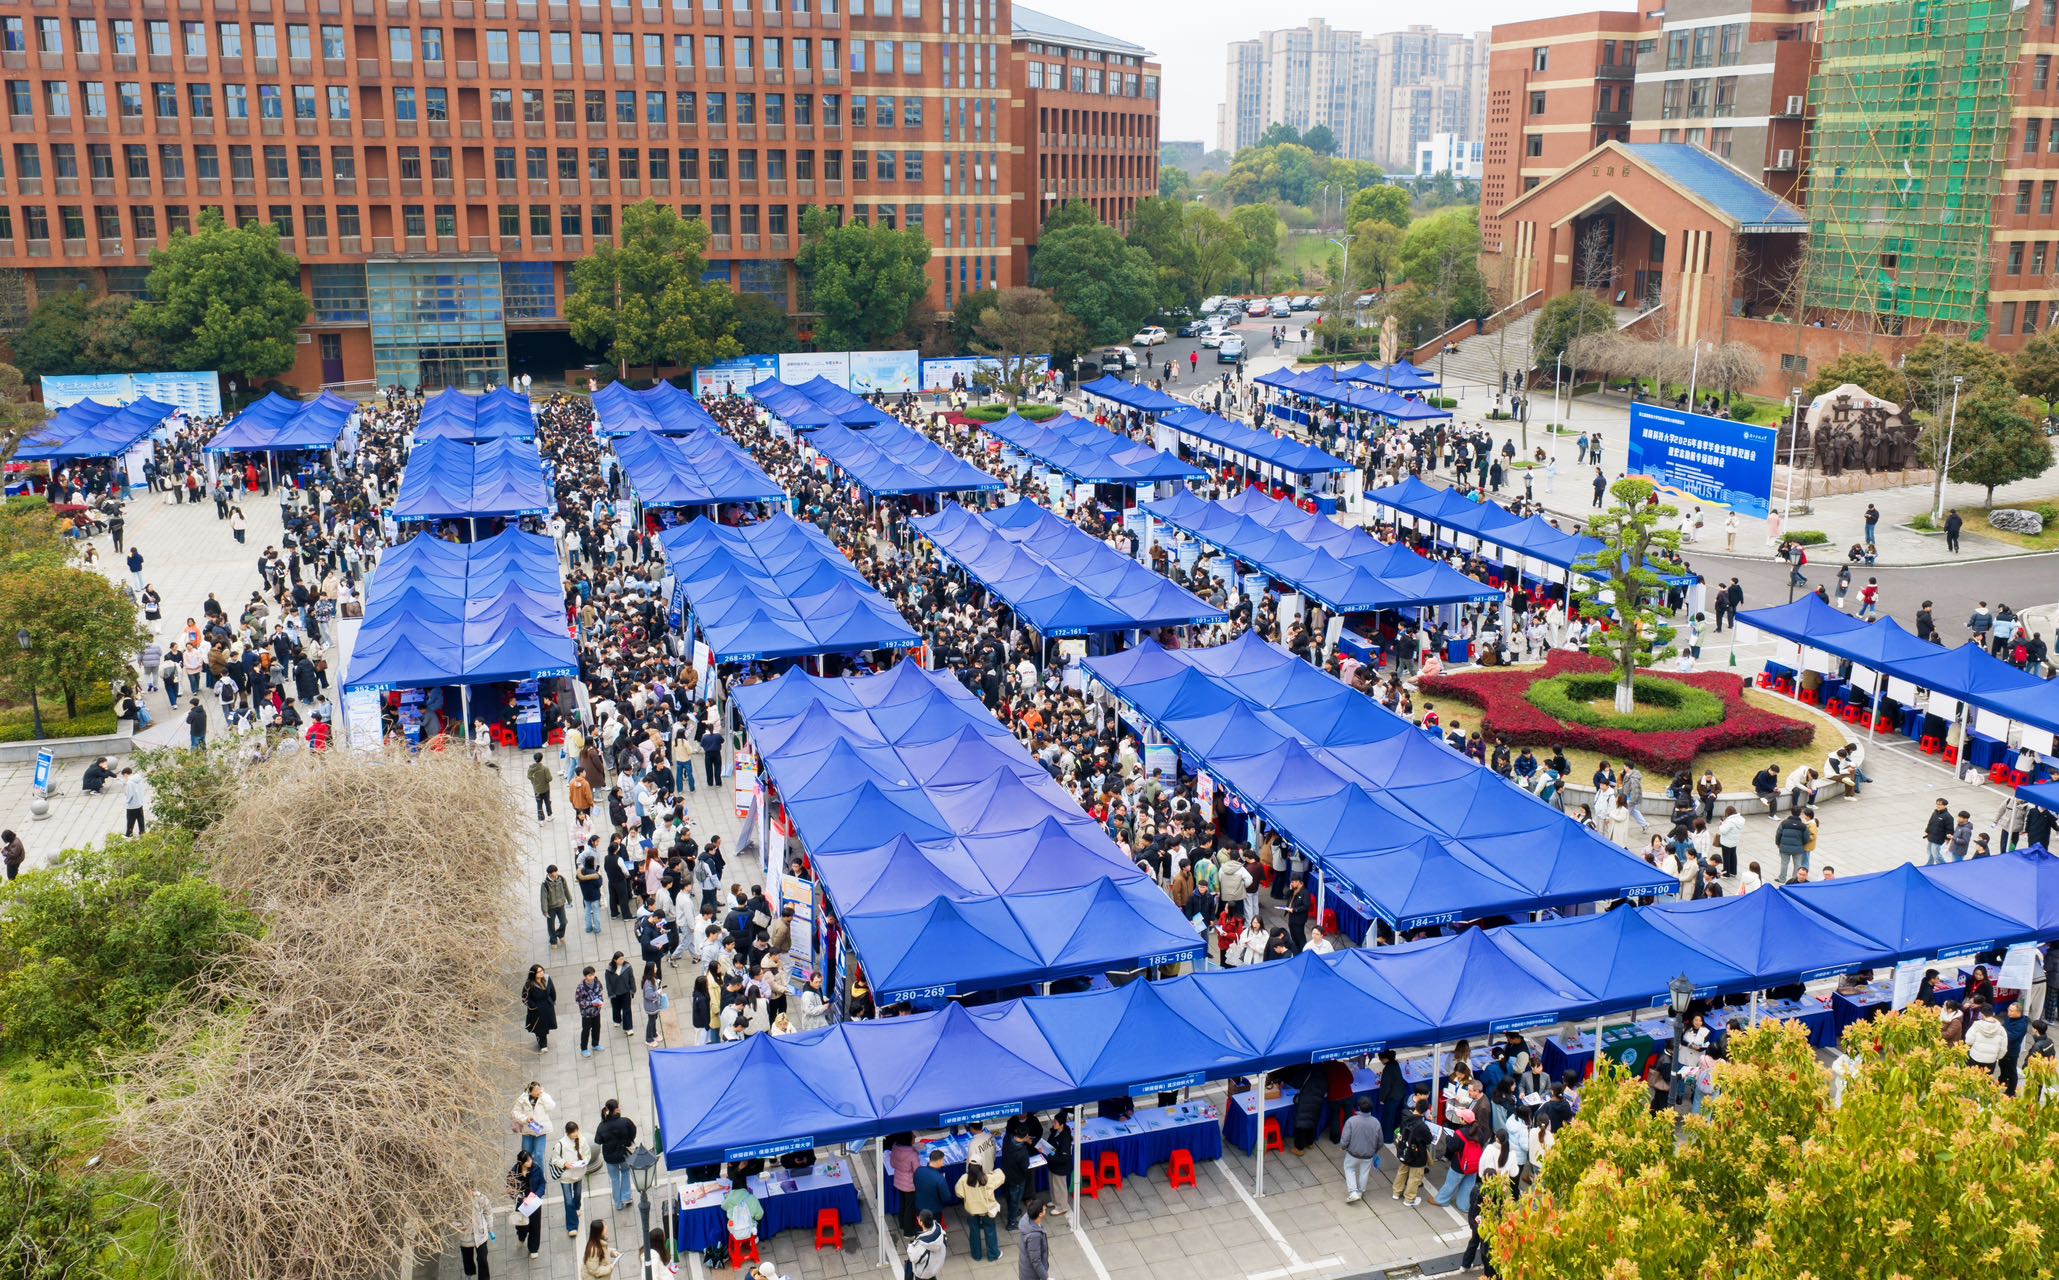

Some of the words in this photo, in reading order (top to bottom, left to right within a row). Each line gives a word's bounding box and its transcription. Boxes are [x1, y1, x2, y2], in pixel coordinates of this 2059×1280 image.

[1055, 628, 1082, 636] 172-161
[885, 640, 915, 648] 197-208
[725, 653, 756, 662] 268-257
[537, 668, 570, 679] 281-292
[1628, 885, 1670, 897] 089-100
[1410, 914, 1453, 930] 184-173
[1148, 949, 1193, 966] 185-196
[895, 986, 946, 1002] 280-269
